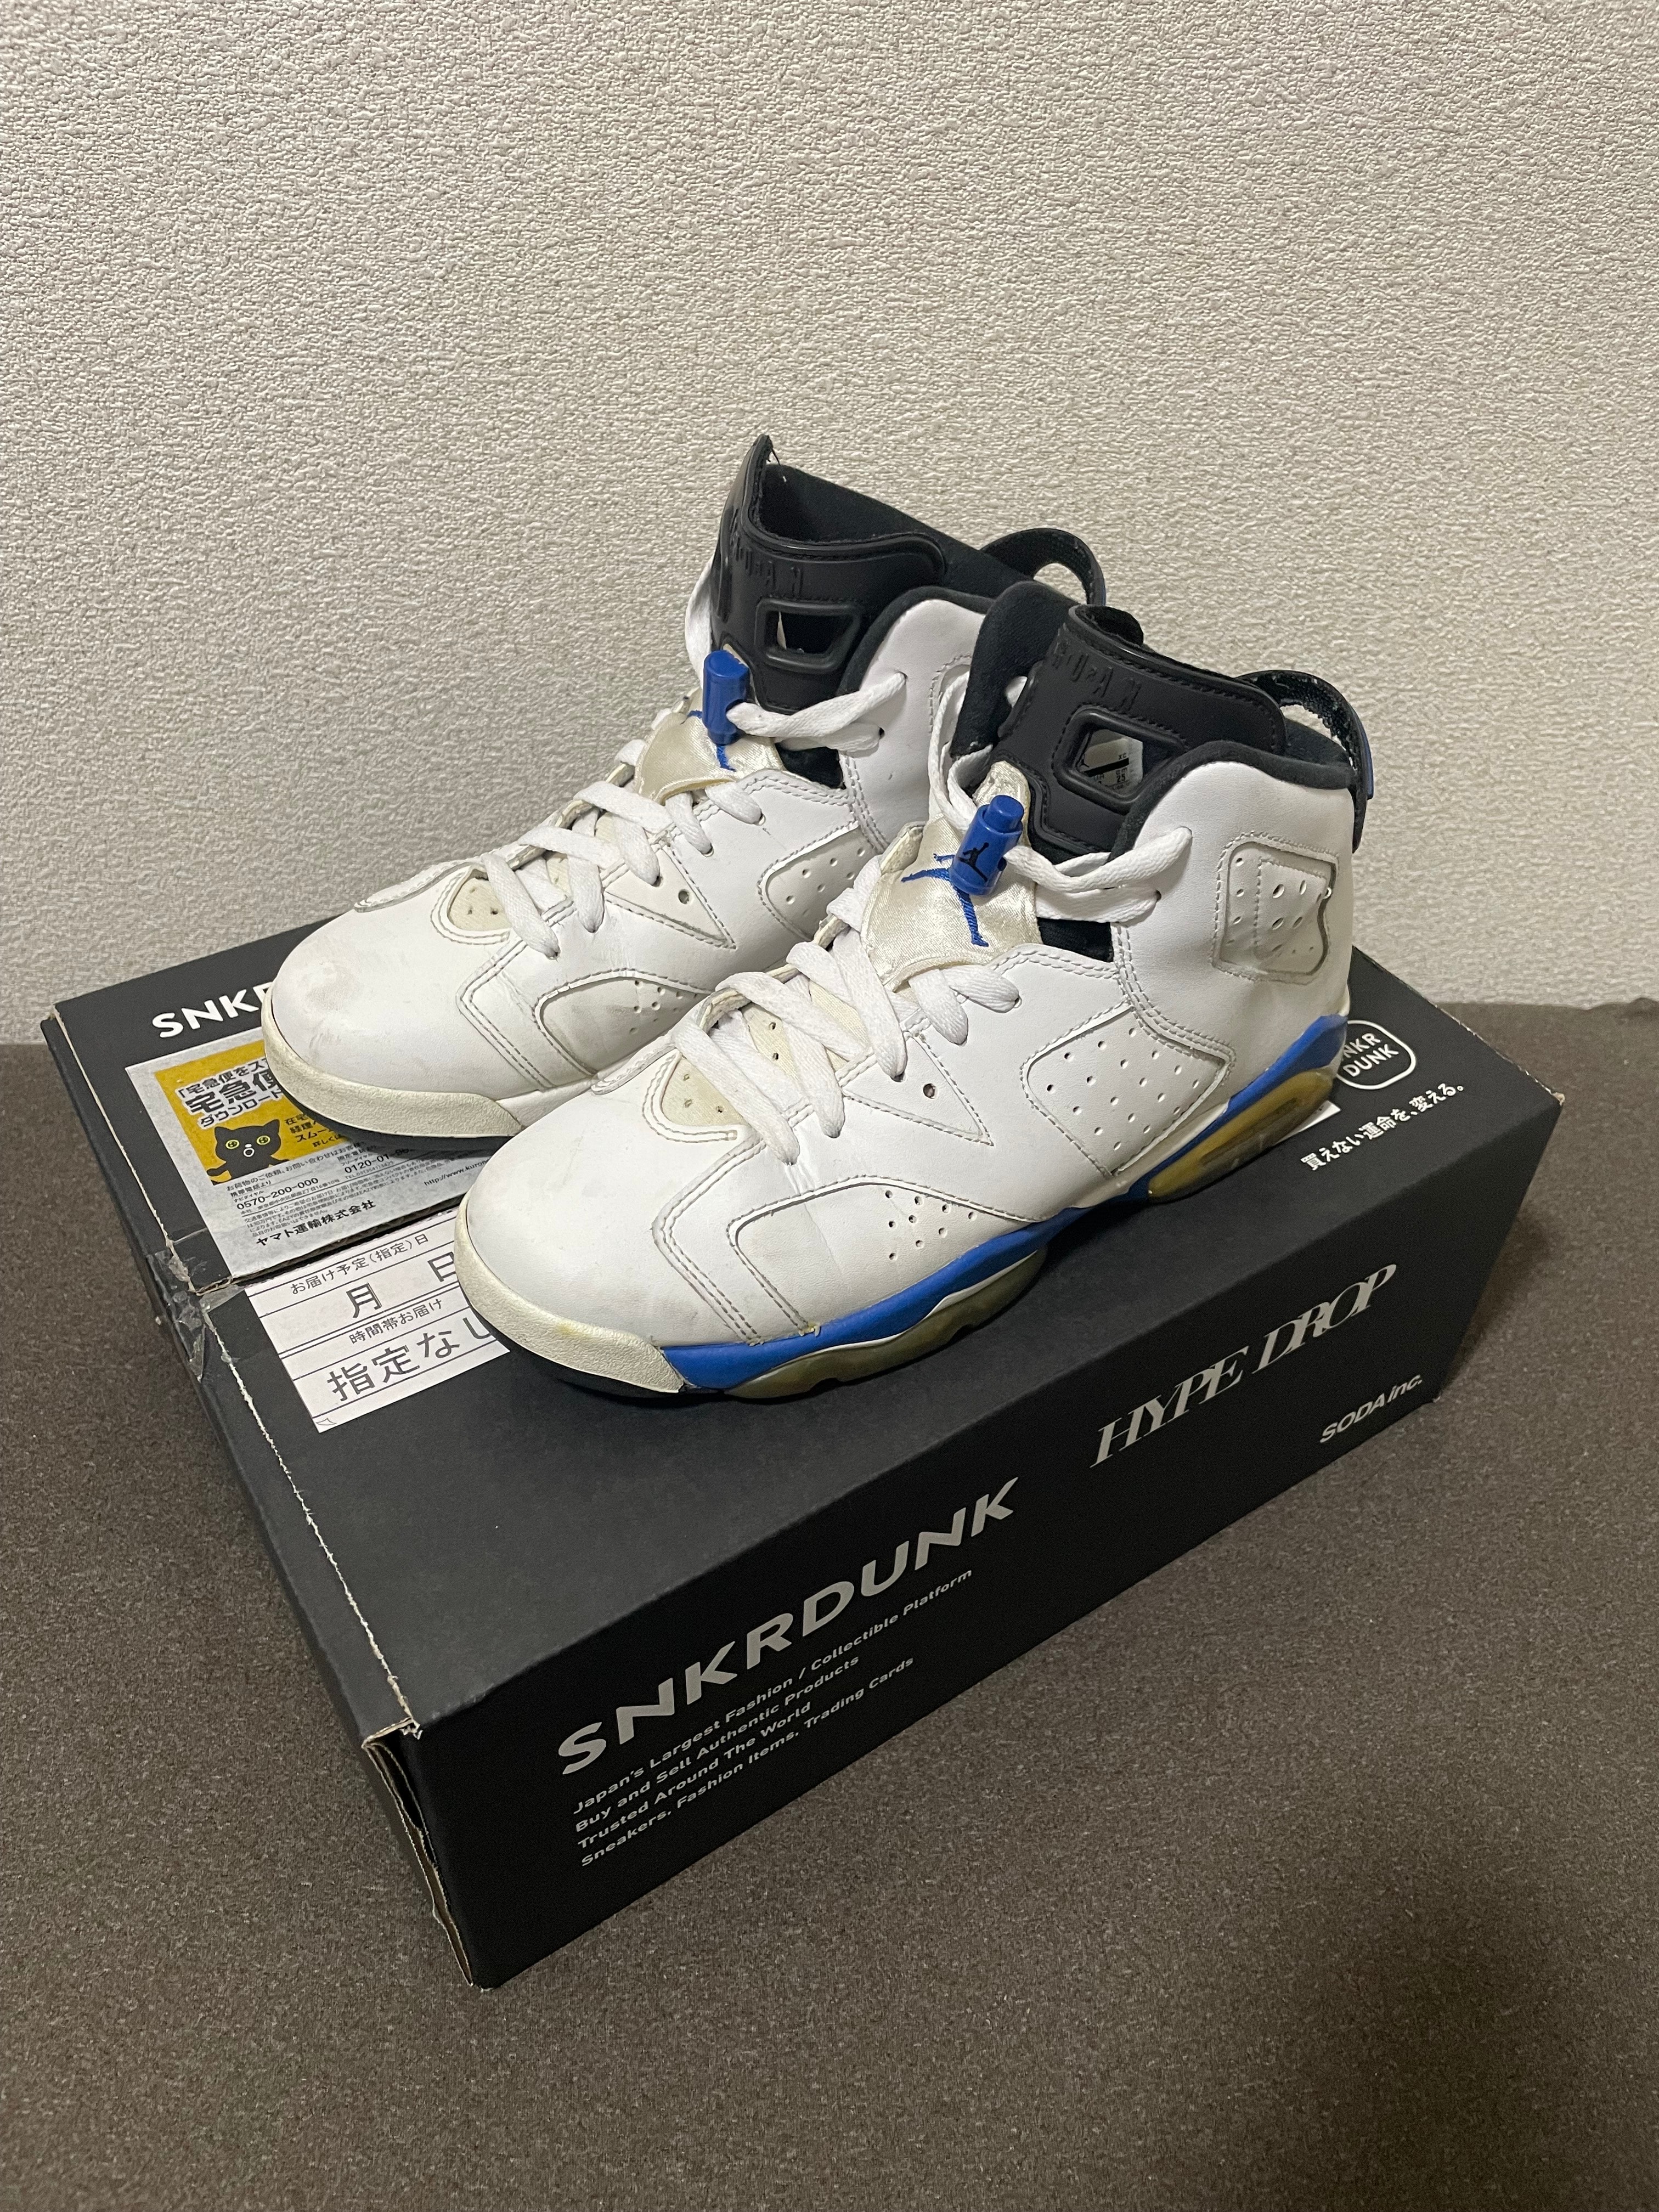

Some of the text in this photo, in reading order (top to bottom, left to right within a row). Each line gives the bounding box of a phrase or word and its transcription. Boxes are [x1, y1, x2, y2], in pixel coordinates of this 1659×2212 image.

[178, 1057, 267, 1098] 「宅急便をス
[1342, 1044, 1399, 1077] DUNK
[1343, 1033, 1381, 1059] NKR
[1300, 1083, 1464, 1171] 買えない運命を、変える。
[236, 1148, 416, 1210] 0570-200-000 0120-01-96
[256, 1200, 376, 1246] ヤマト運輸株式会社
[346, 1282, 382, 1318] 月
[349, 1298, 442, 1344] 時間帯お届け
[327, 1317, 492, 1402] 指定なし
[1090, 1263, 1397, 1468] HYPE DROP
[1319, 1374, 1423, 1443] SODA inc.
[557, 1476, 1019, 1775] SNKRDUNK
[573, 1767, 644, 1814] Japan's
[650, 1720, 720, 1769] Largest
[725, 1678, 793, 1723] Fashion
[811, 1615, 899, 1671] Collectible
[903, 1570, 972, 1616] Platform
[575, 1656, 859, 1833] Buy and Sell Authentic Products
[578, 1701, 811, 1849] Trusted Around The World
[582, 1810, 672, 1866] Sneakers,
[676, 1763, 743, 1809] Fashion
[804, 1688, 865, 1728] Trading
[868, 1657, 914, 1689] Cards
